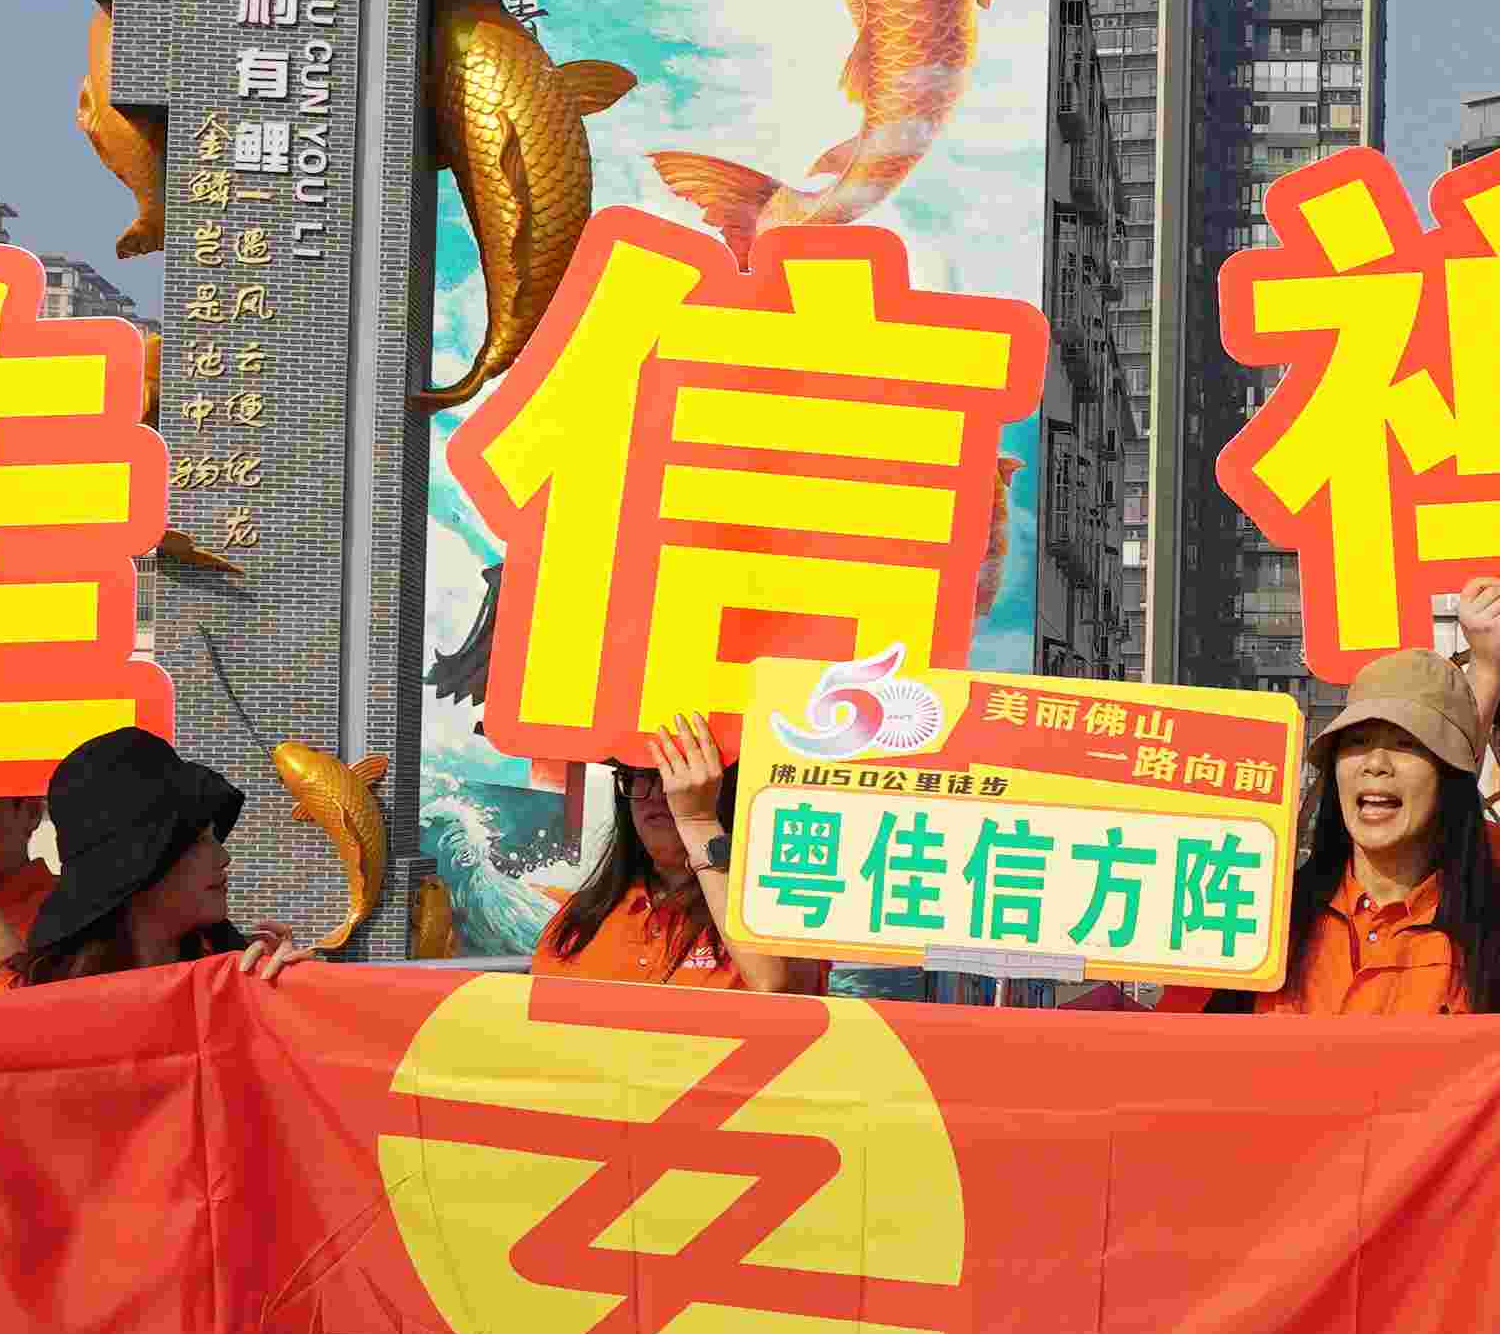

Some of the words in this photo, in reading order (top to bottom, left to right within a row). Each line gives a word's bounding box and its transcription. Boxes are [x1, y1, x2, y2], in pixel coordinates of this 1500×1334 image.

[301, 38, 333, 116] CUN
[296, 122, 329, 204] YOU
[293, 222, 324, 259] LI
[482, 240, 1012, 735] 信
[984, 688, 1174, 745] 美丽佛山
[769, 763, 1009, 798] 佛山50公里徒步
[1087, 744, 1279, 796] 一路向前
[758, 802, 1261, 957] 粤佳信方阵
